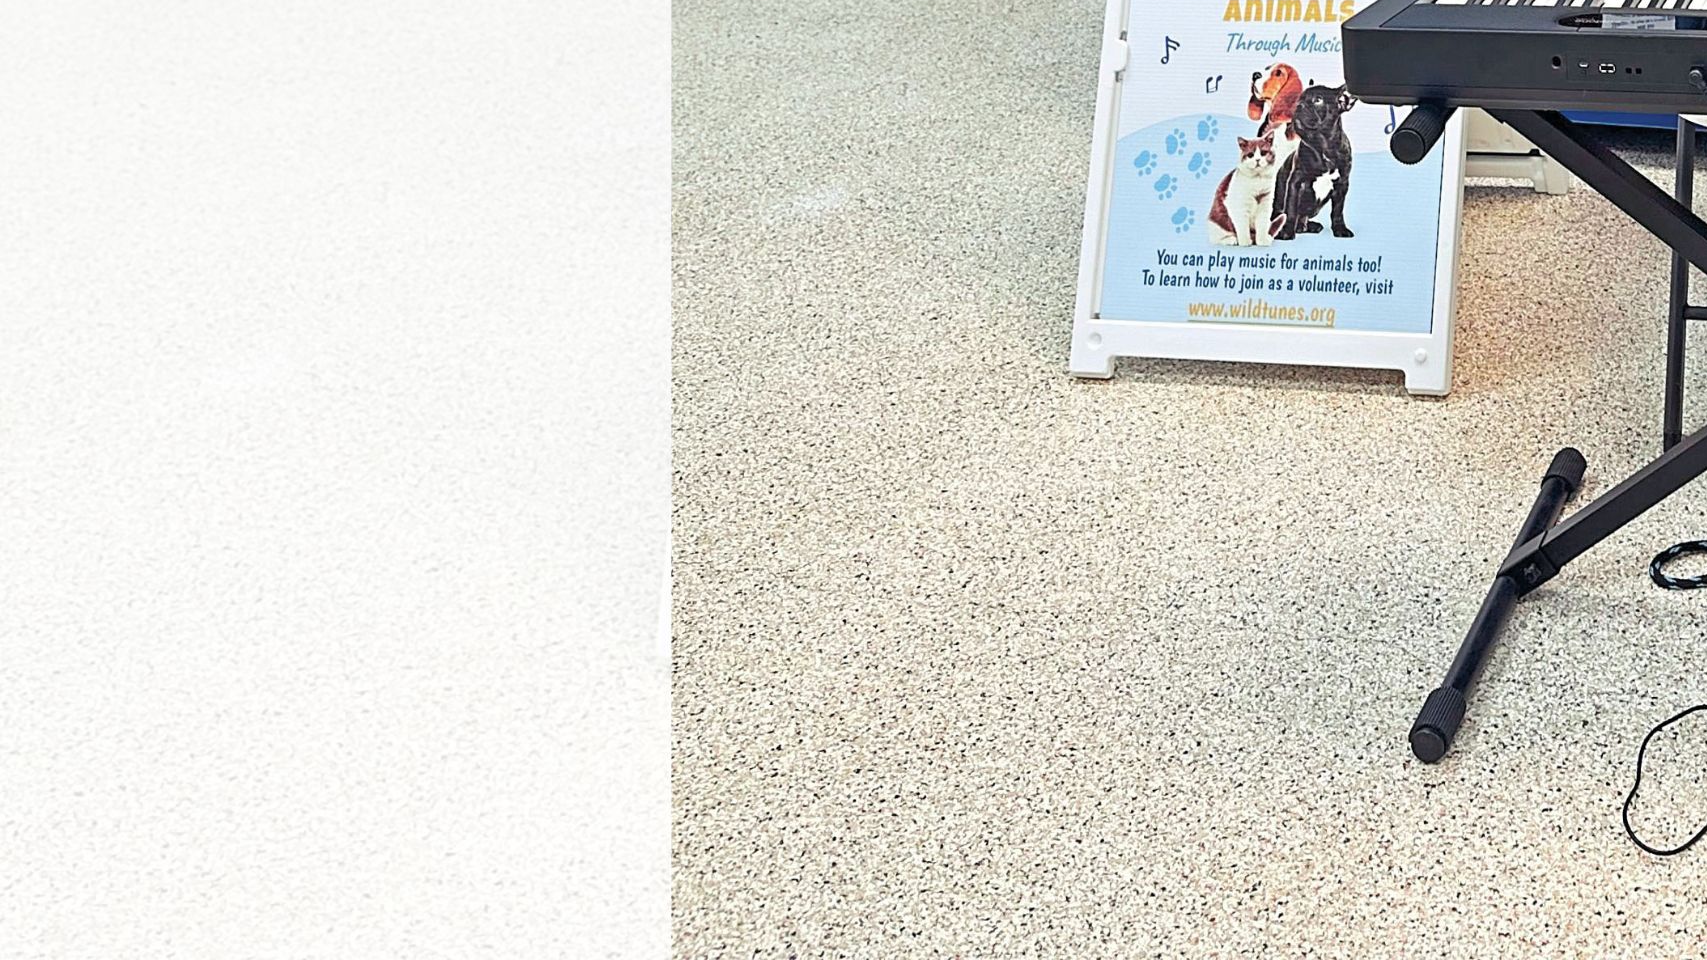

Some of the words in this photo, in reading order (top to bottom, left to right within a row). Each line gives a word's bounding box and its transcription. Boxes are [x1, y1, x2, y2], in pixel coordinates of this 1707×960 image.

[1226, 33, 1291, 57] Through
[1295, 34, 1342, 54] Music
[1157, 249, 1178, 266] You
[1182, 254, 1204, 267] can
[1208, 250, 1234, 272] play
[1239, 253, 1276, 270] music
[1281, 253, 1298, 270] for
[1303, 254, 1353, 272] animals
[1358, 256, 1382, 273] too!
[1142, 269, 1155, 286] To
[1159, 270, 1190, 287] learn
[1195, 271, 1220, 288] how
[1224, 274, 1236, 289] to
[1239, 275, 1264, 294] join
[1268, 279, 1282, 290] as
[1287, 280, 1294, 291] a
[1298, 275, 1360, 296] volunteer,
[1365, 278, 1394, 295] visit
[1188, 298, 1336, 327] www.wildtunes.org
